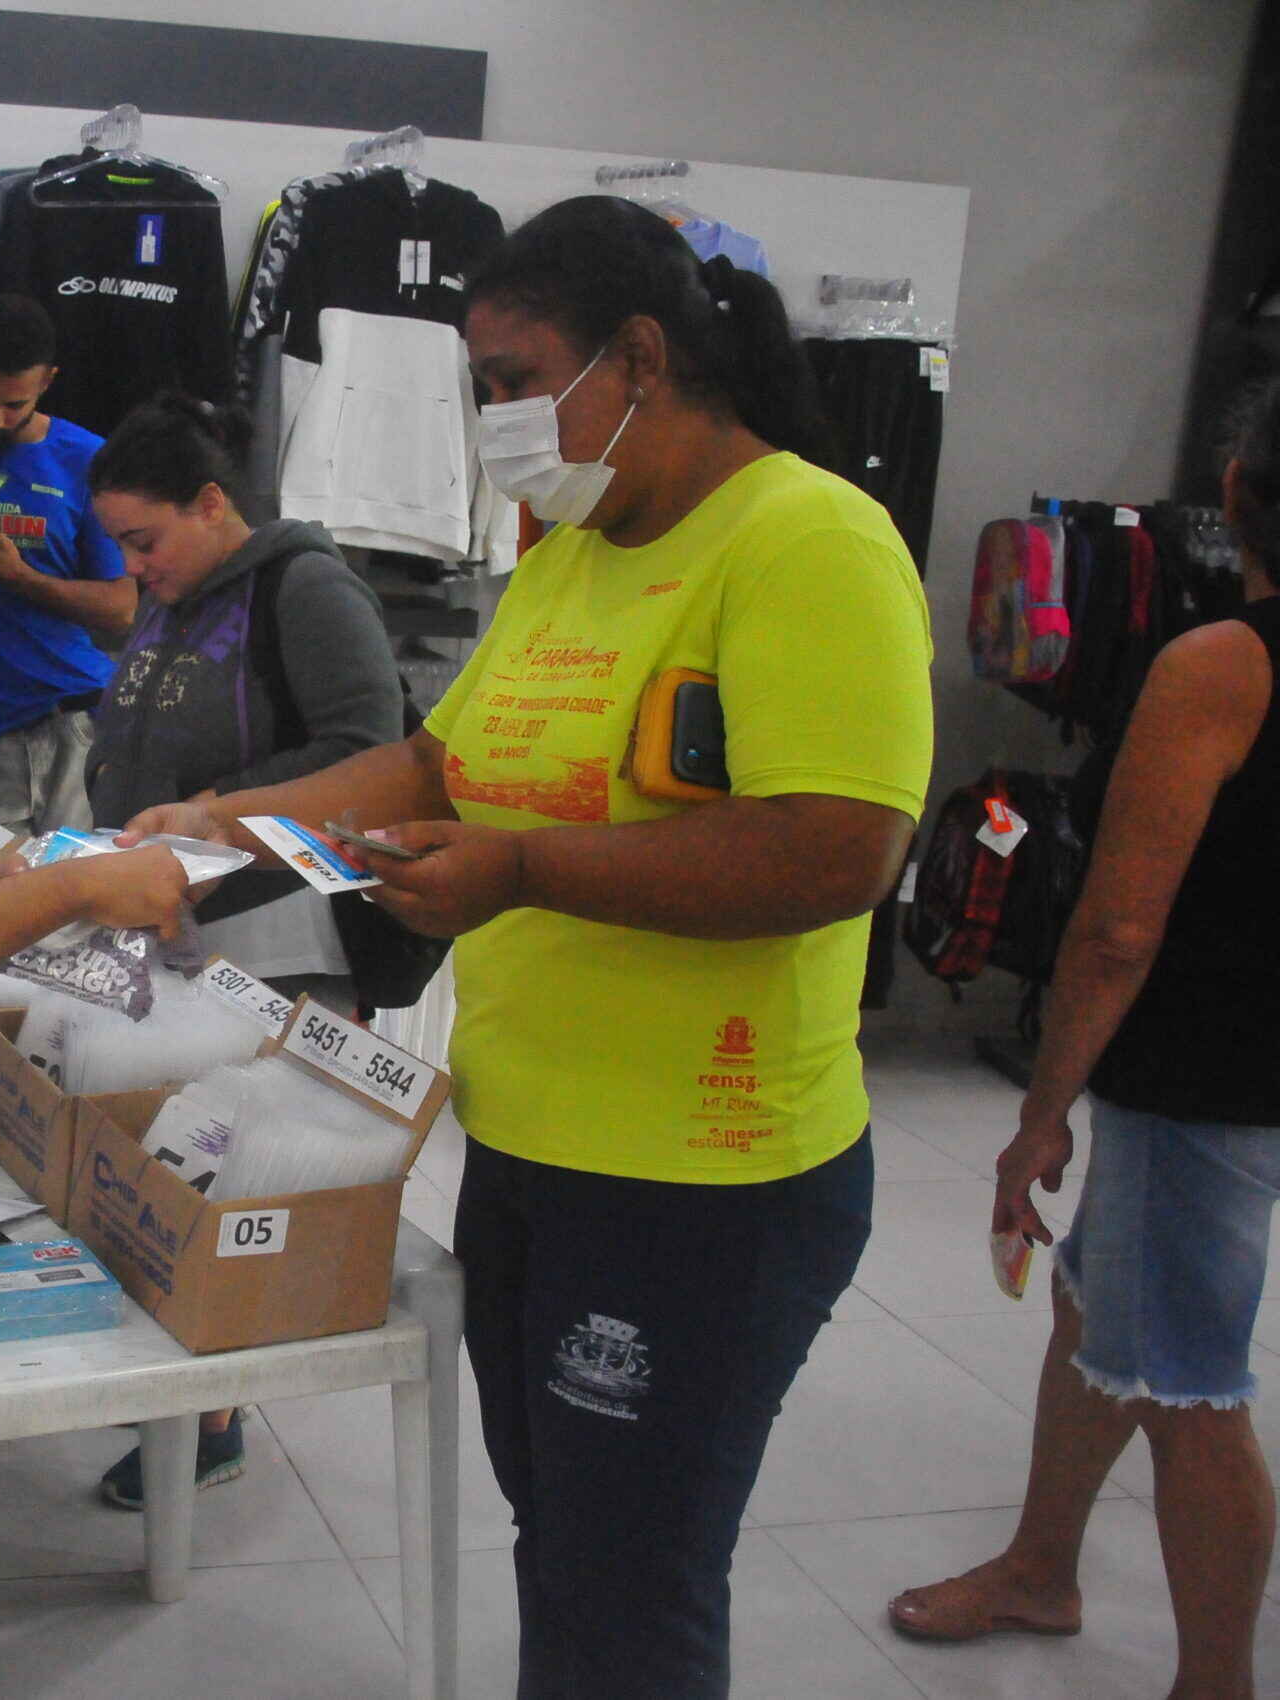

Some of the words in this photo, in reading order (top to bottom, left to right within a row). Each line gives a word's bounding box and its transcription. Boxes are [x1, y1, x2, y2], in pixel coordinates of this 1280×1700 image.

[211, 967, 253, 997] 5301
[259, 999, 293, 1022] 545
[302, 1015, 349, 1057] 5451
[365, 1052, 417, 1098] 5544
[725, 1097, 761, 1113] RUN
[234, 1216, 273, 1247] 05
